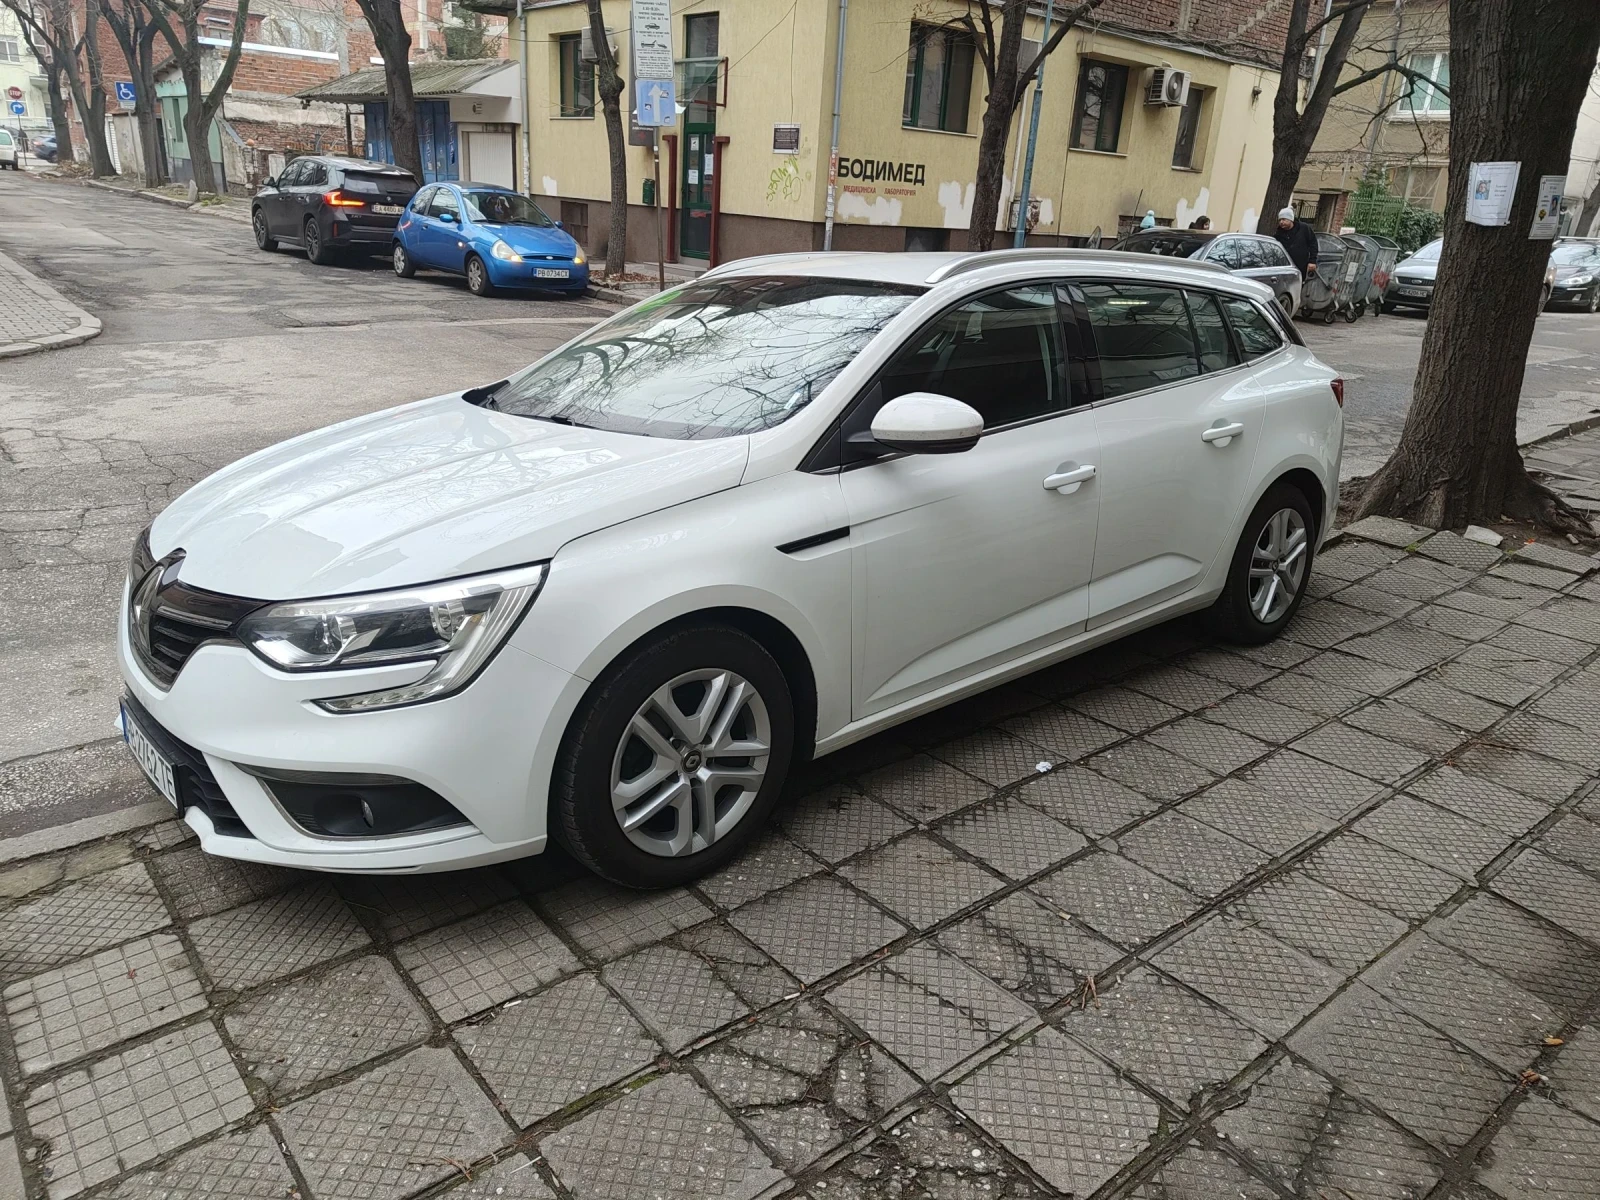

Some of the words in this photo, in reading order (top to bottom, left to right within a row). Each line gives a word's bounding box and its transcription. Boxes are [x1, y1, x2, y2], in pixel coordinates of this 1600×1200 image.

[837, 157, 925, 186] БОДИМЕД
[843, 185, 876, 194] МЕДИЦИНСКА
[884, 187, 916, 196] ЛАБОРАТОРИЯ
[157, 755, 176, 801] TE
